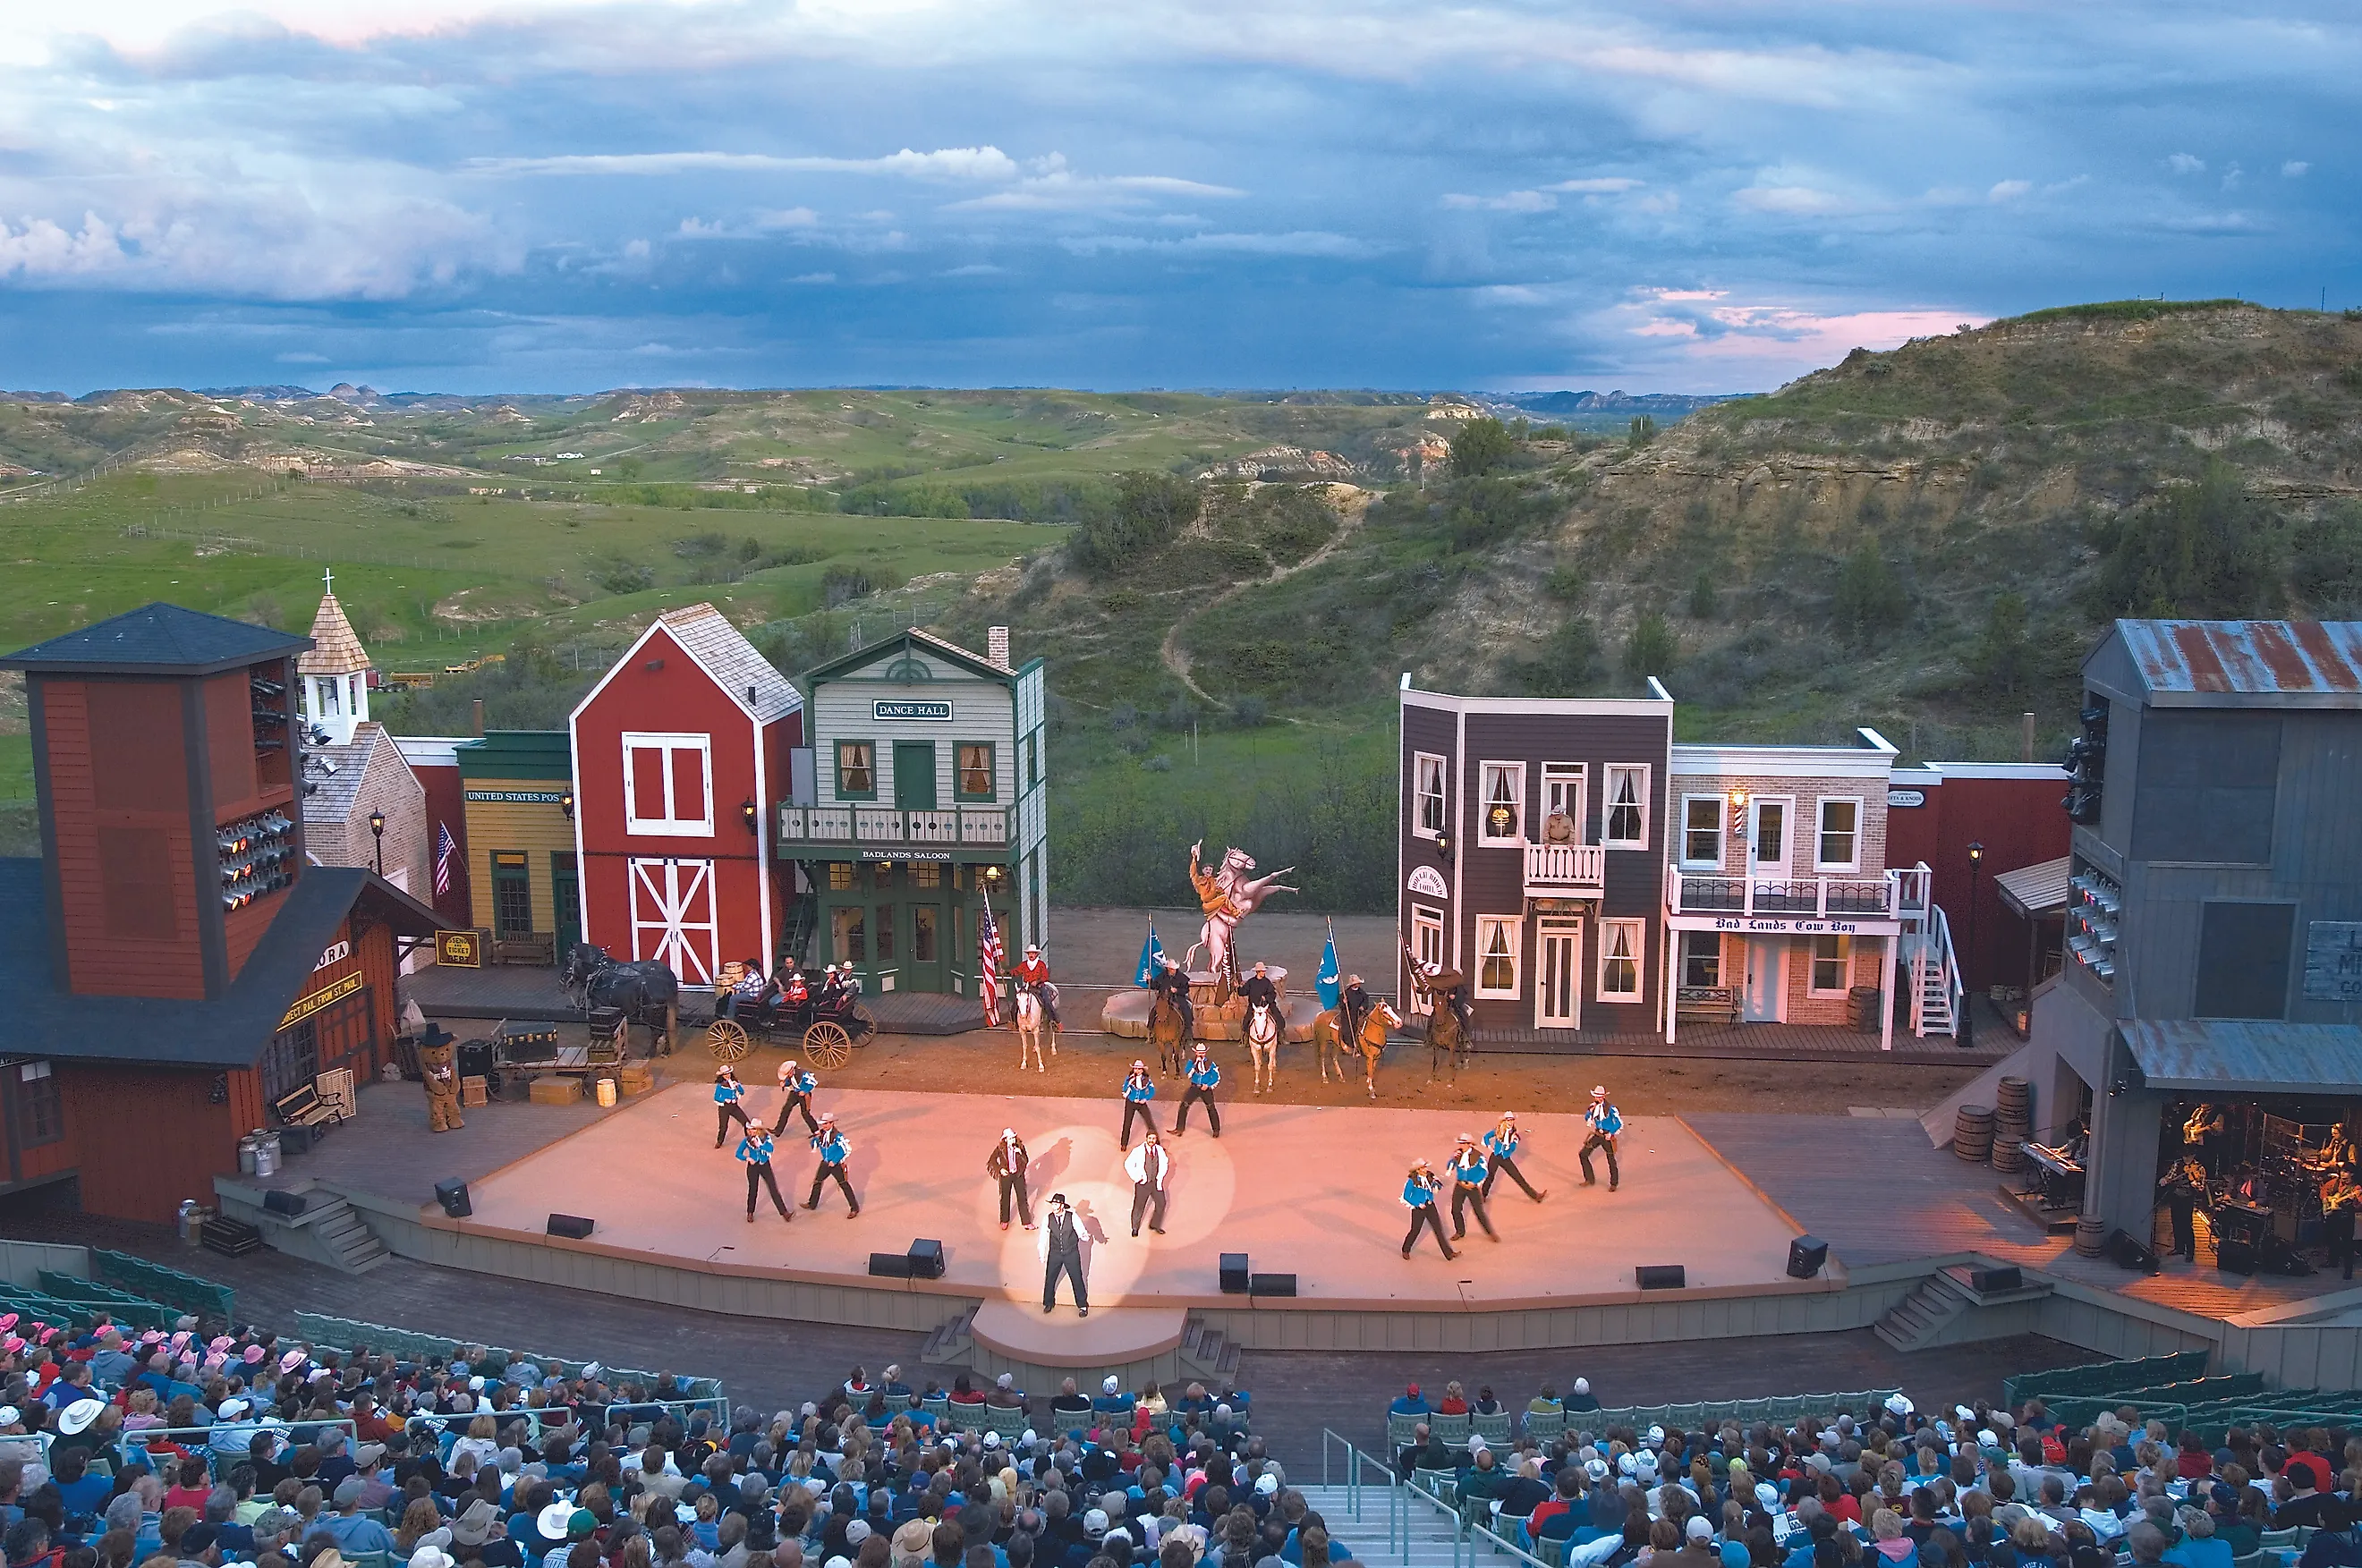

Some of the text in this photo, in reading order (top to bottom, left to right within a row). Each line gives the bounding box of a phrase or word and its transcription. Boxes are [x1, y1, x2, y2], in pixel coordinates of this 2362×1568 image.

[879, 706, 947, 715] DANCE HALL
[468, 792, 561, 802] UNITED STATES POS
[862, 851, 950, 860] BADLANDS SALOON
[1715, 918, 1856, 934] Bad Lands Cow Boy
[447, 946, 470, 954] TICKET
[302, 999, 316, 1013] RAIL
[318, 990, 333, 1006] FROM
[344, 978, 358, 992] PAUL
